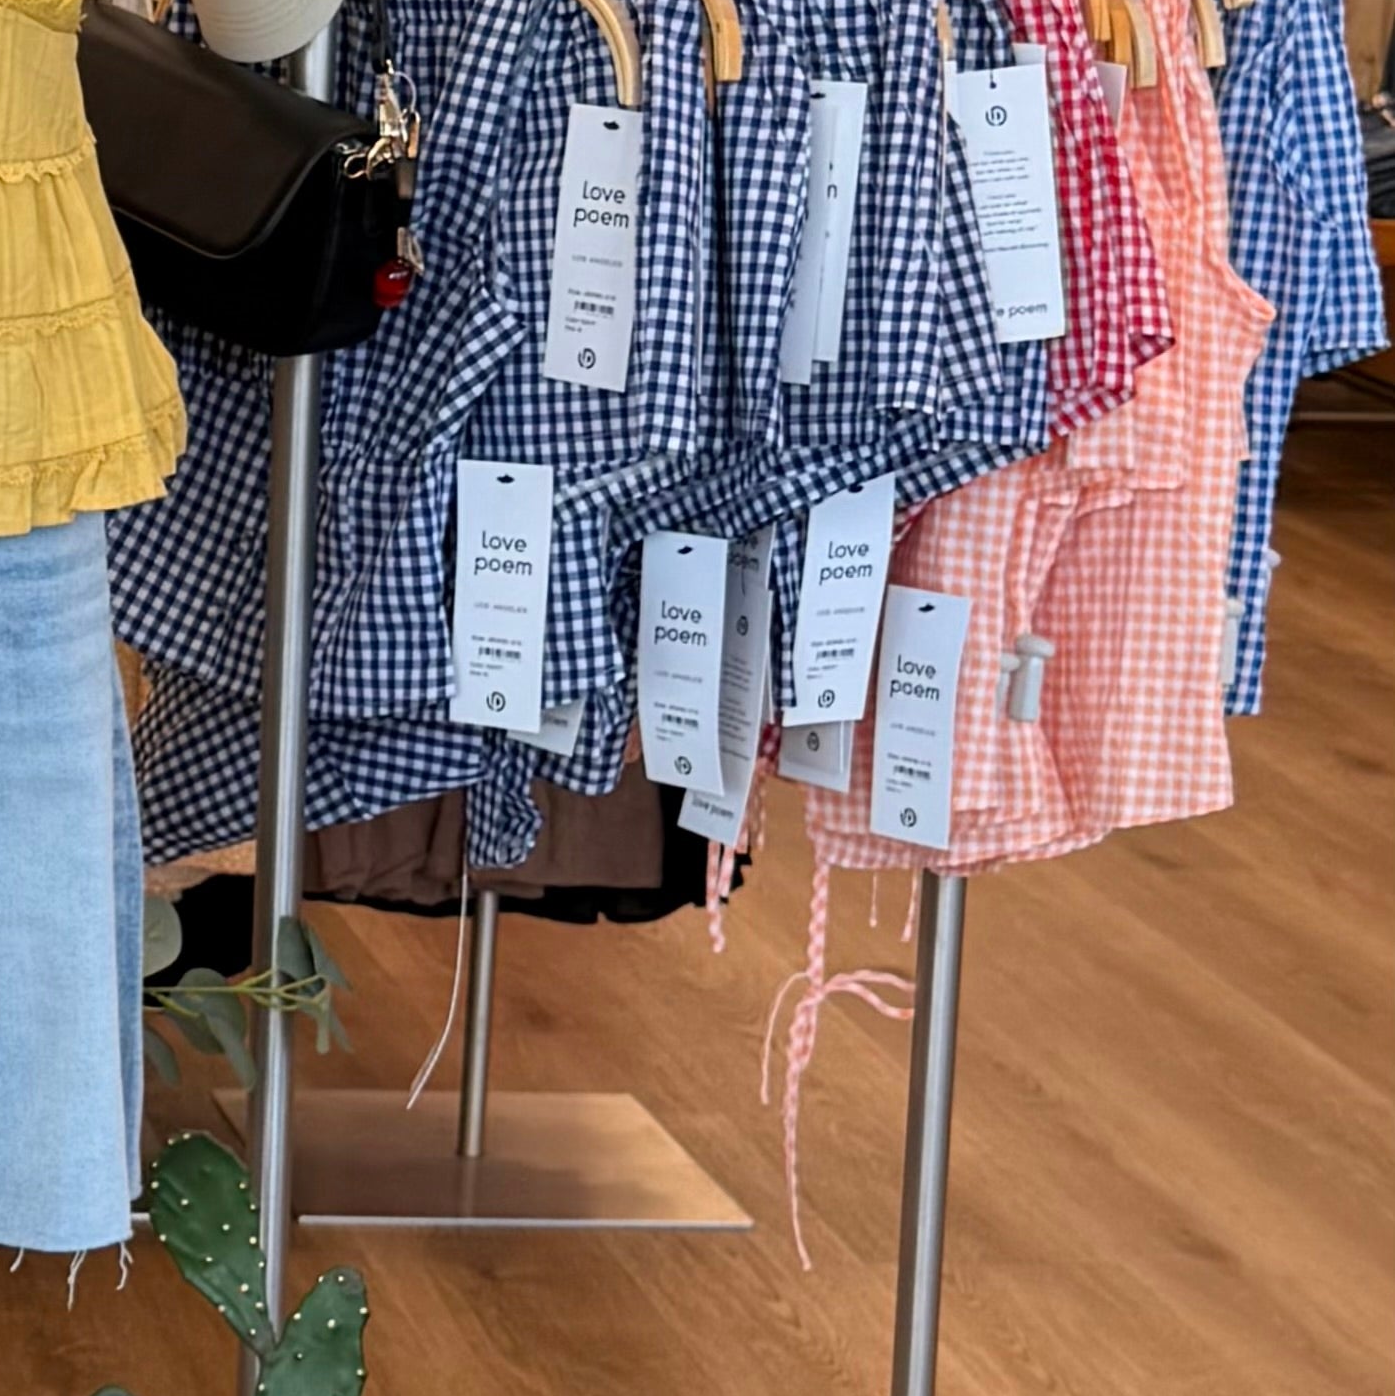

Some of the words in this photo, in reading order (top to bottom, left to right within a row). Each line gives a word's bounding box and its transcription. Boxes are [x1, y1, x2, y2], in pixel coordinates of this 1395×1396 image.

[573, 207, 630, 229] poem
[473, 556, 533, 576] poem
[818, 564, 873, 586] poem
[654, 625, 707, 647] poem
[889, 679, 940, 702] poem
